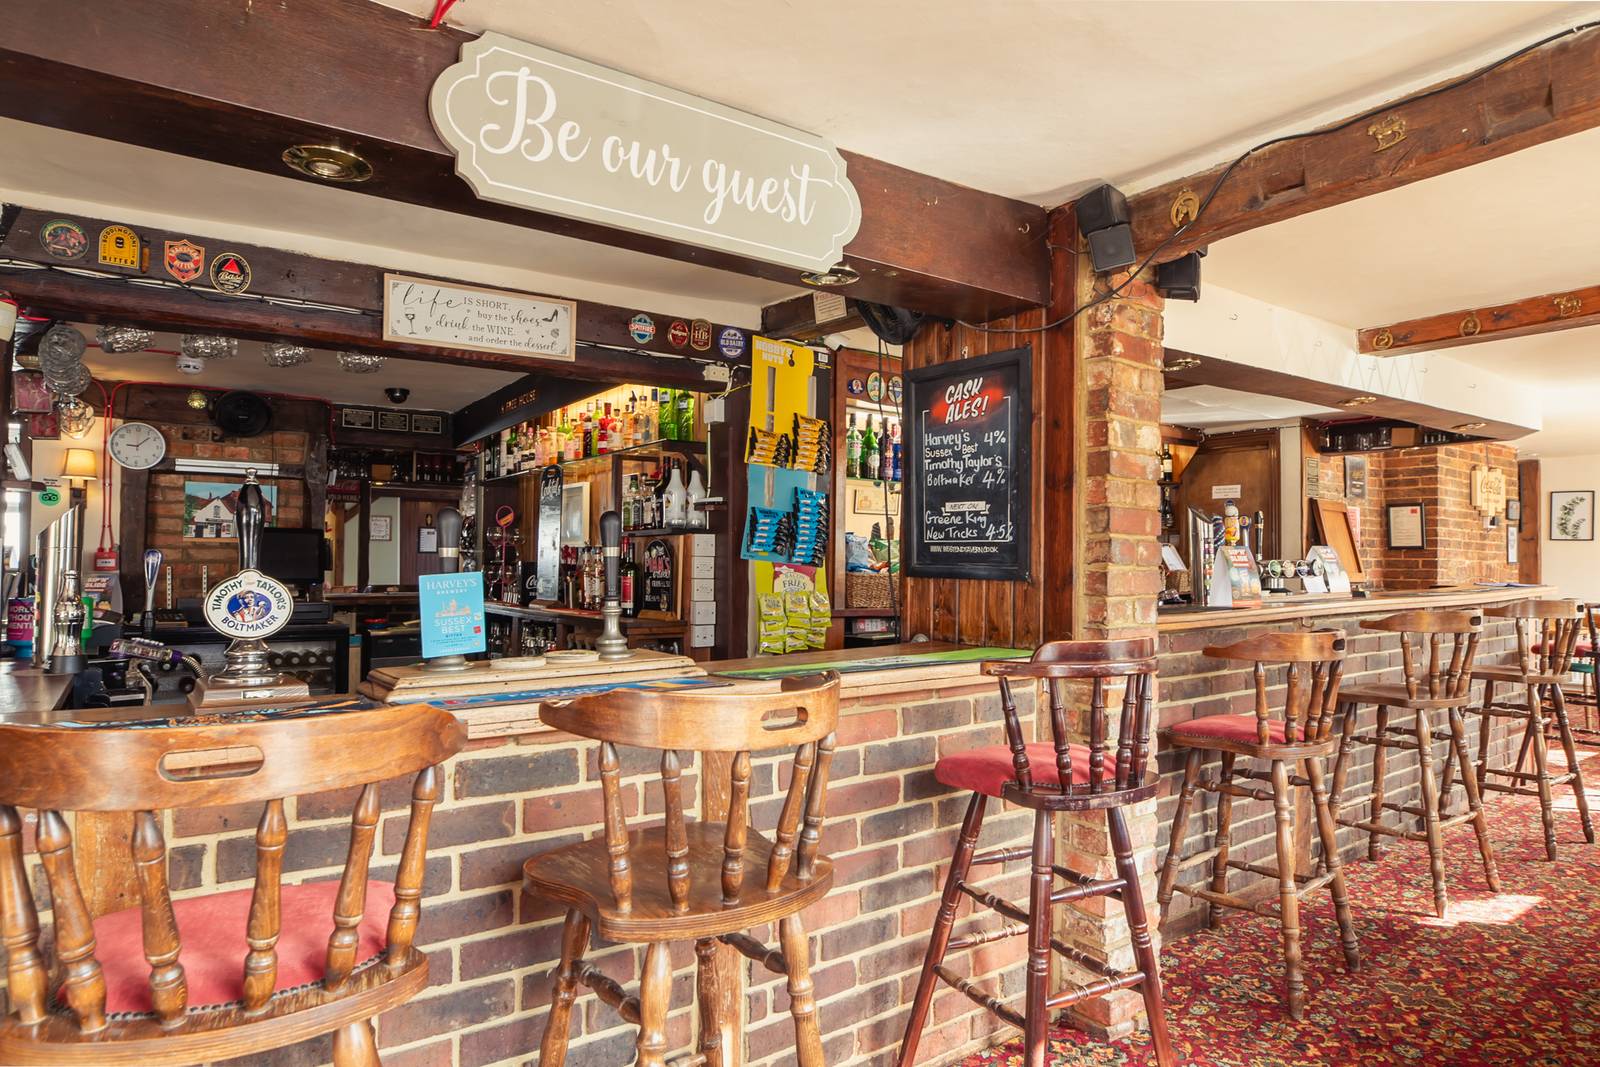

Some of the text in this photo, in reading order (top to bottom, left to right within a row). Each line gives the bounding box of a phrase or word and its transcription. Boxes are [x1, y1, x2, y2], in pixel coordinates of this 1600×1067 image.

[480, 66, 834, 226] Be our guest
[102, 255, 135, 265] BITTER
[217, 271, 244, 281] Bass
[402, 283, 463, 317] life
[464, 296, 474, 305] IS
[435, 313, 470, 330] drink
[472, 324, 485, 332] the
[477, 310, 493, 322] buy
[495, 313, 508, 321] the
[468, 335, 484, 343] and
[486, 337, 508, 346] order
[509, 339, 522, 347] the
[945, 377, 983, 404] CASK
[945, 395, 989, 424] ALES!
[925, 429, 1006, 451] Harvey's 4%
[925, 442, 978, 458] Sussex Best
[924, 454, 1003, 474] Timothy Taylor's
[982, 468, 1006, 488] 4%
[925, 510, 987, 528] Greene King
[926, 527, 945, 540] New
[945, 526, 978, 539] Tricks
[425, 577, 478, 591] HARVEY'S
[783, 580, 808, 590] FRIES
[212, 580, 286, 611] TIMOTHY TAYLOR'S
[221, 614, 279, 632] BOLTMAKER
[434, 614, 472, 627] SUSSEX
[441, 624, 466, 634] BEST
